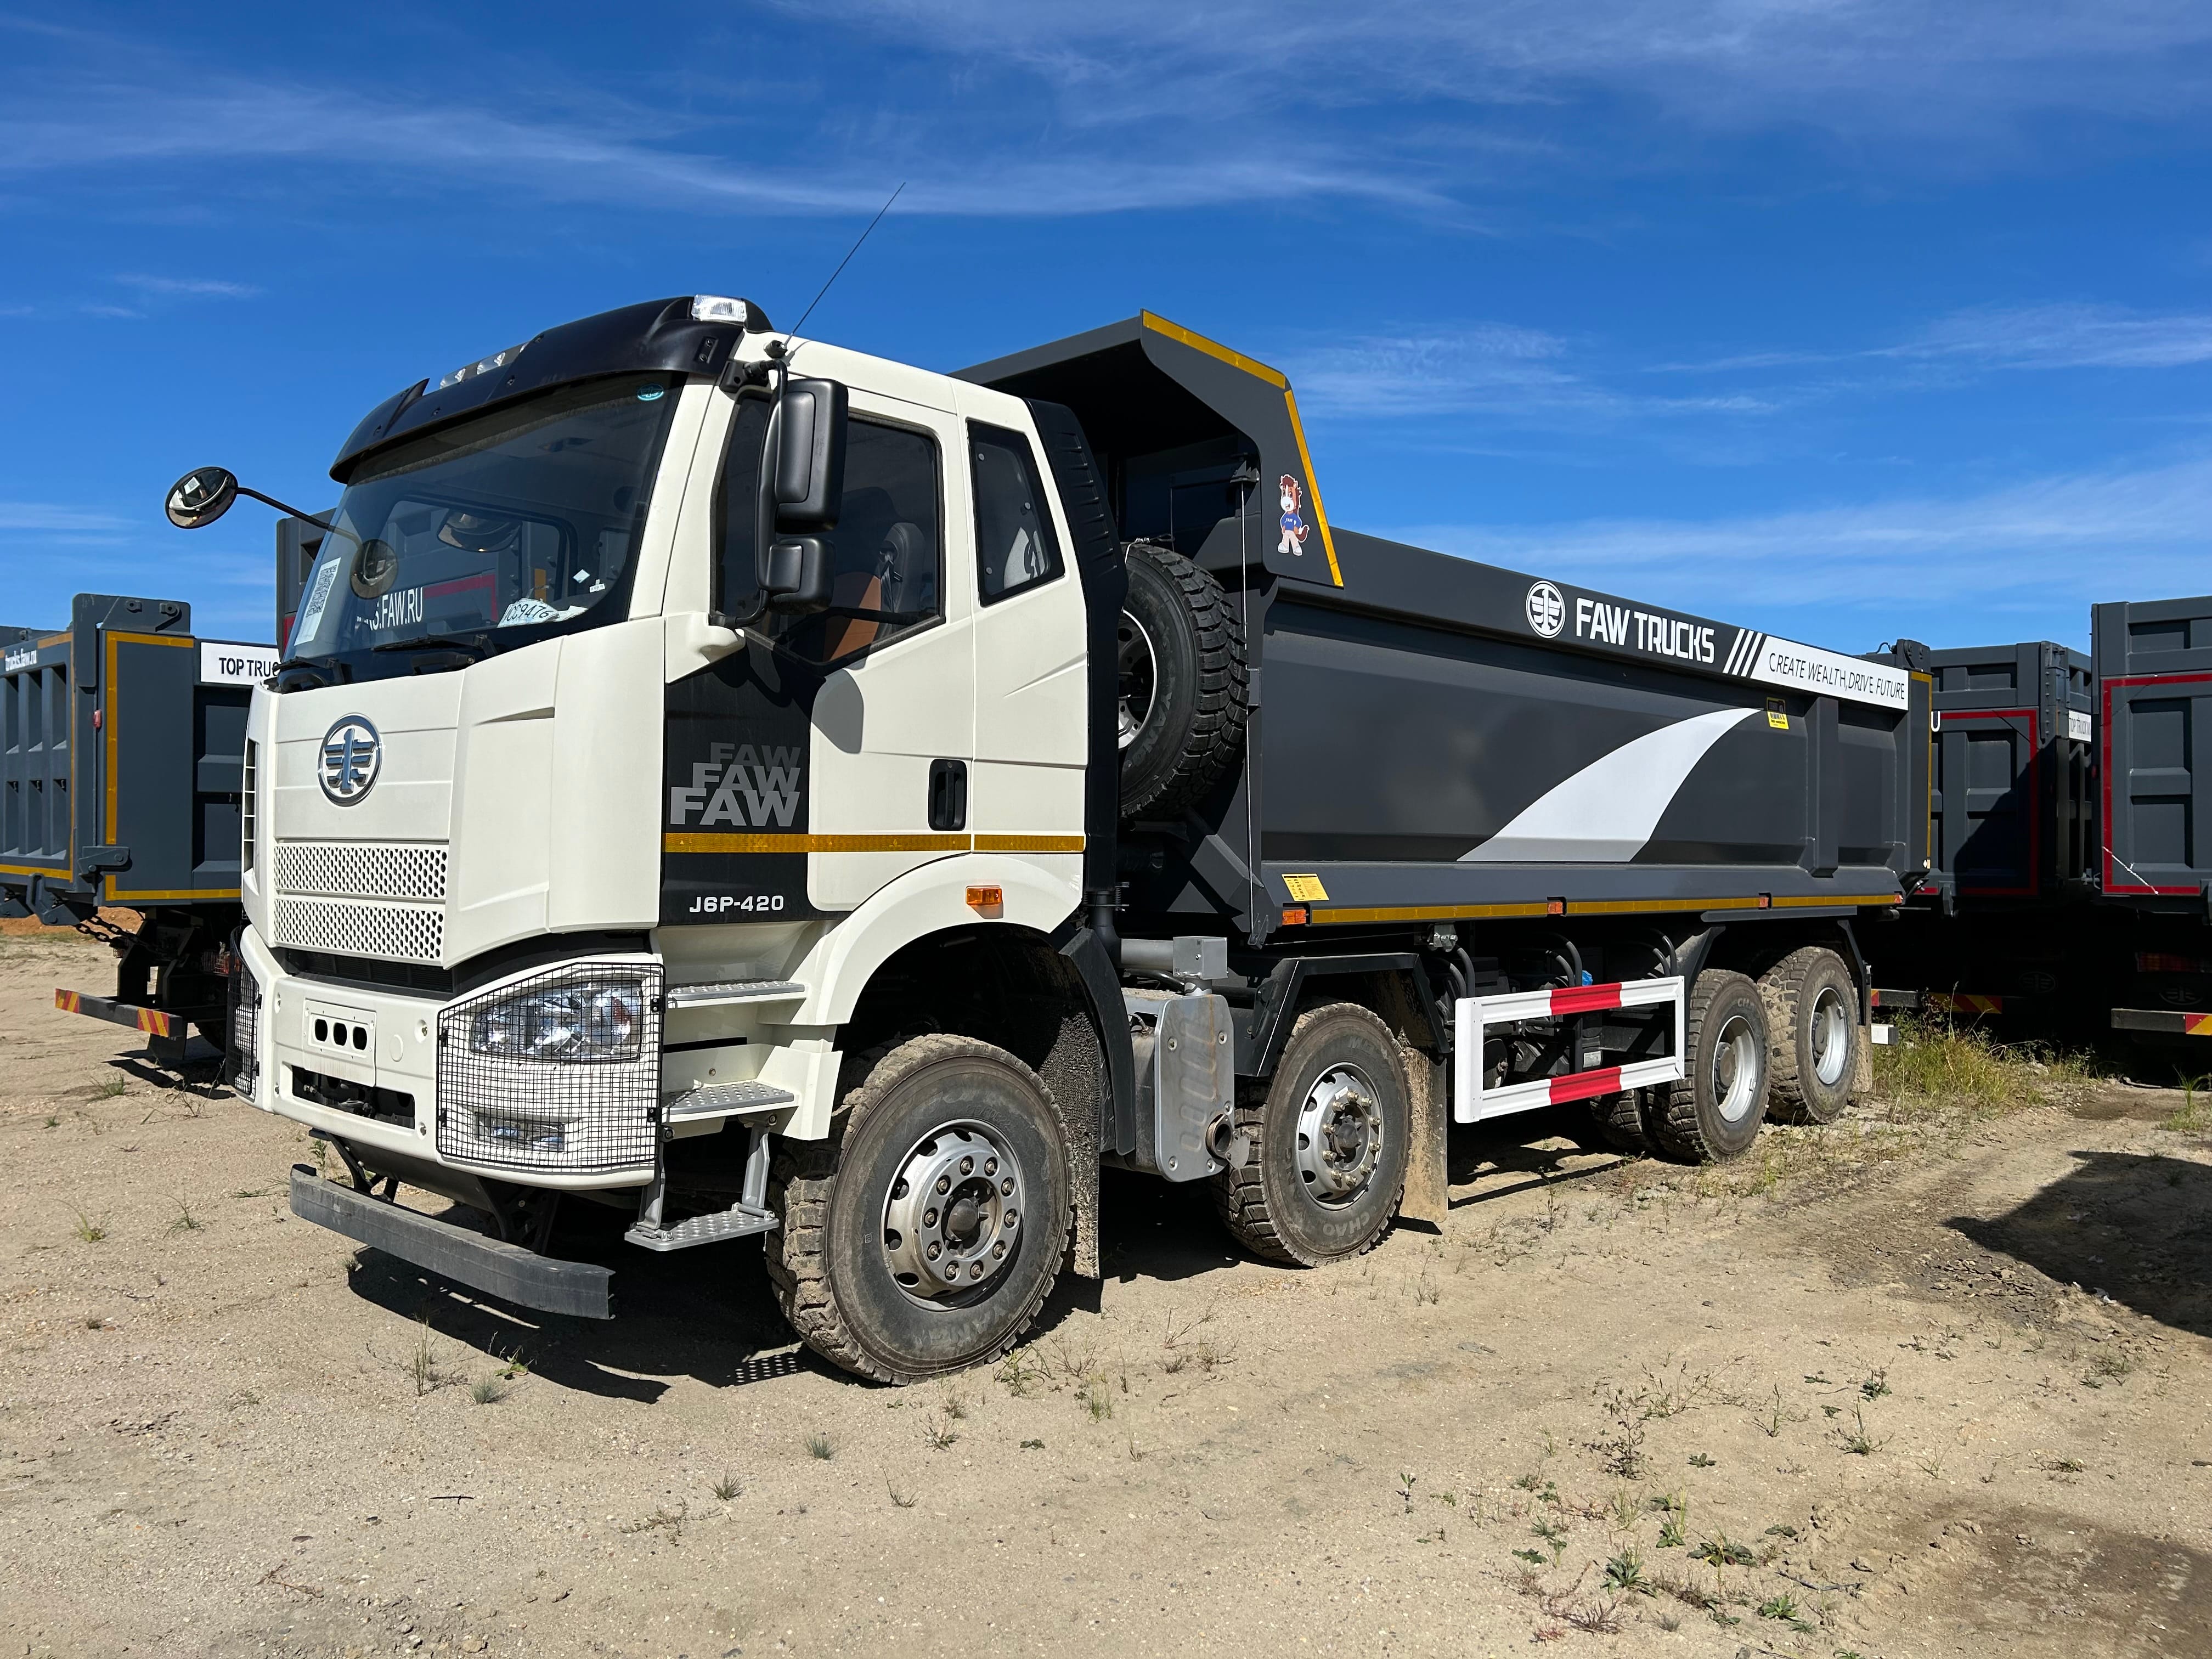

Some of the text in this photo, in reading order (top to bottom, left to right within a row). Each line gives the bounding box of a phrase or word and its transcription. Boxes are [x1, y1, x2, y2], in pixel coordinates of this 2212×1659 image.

[1576, 597, 1714, 664] FAW TRUCKS
[219, 657, 244, 675] TOP
[1769, 653, 1806, 678] CREATE
[1876, 678, 1905, 699] FUTURE
[710, 742, 801, 772] FAW
[692, 763, 800, 797] FAW
[670, 787, 800, 826] FAW
[689, 895, 784, 912] J6P-420
